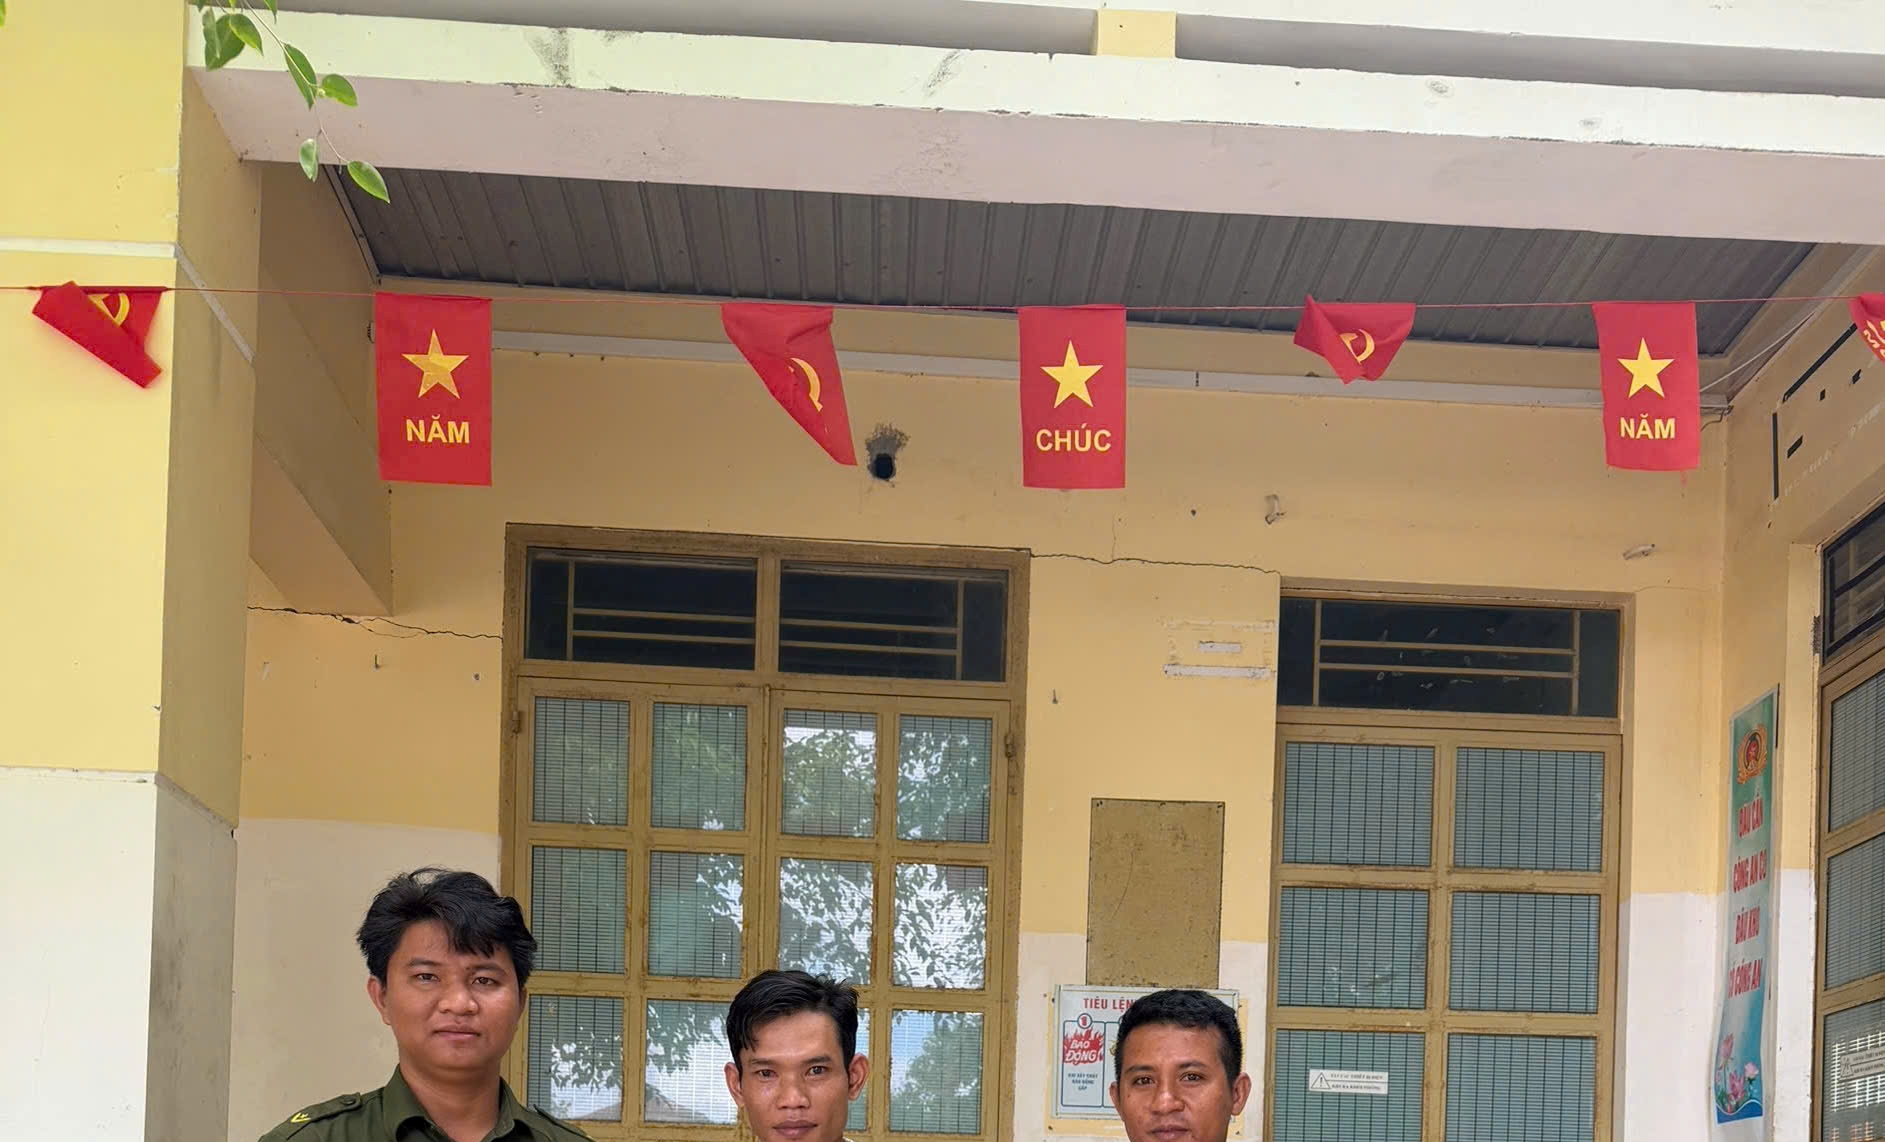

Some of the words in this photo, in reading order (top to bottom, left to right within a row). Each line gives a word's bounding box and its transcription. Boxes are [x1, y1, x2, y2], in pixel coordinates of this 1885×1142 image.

[405, 413, 470, 444] NĂM
[1035, 422, 1112, 452] CHÚC
[1620, 412, 1676, 440] NĂM
[1083, 995, 1108, 1010] TIÊU
[1112, 996, 1137, 1013] LỆN
